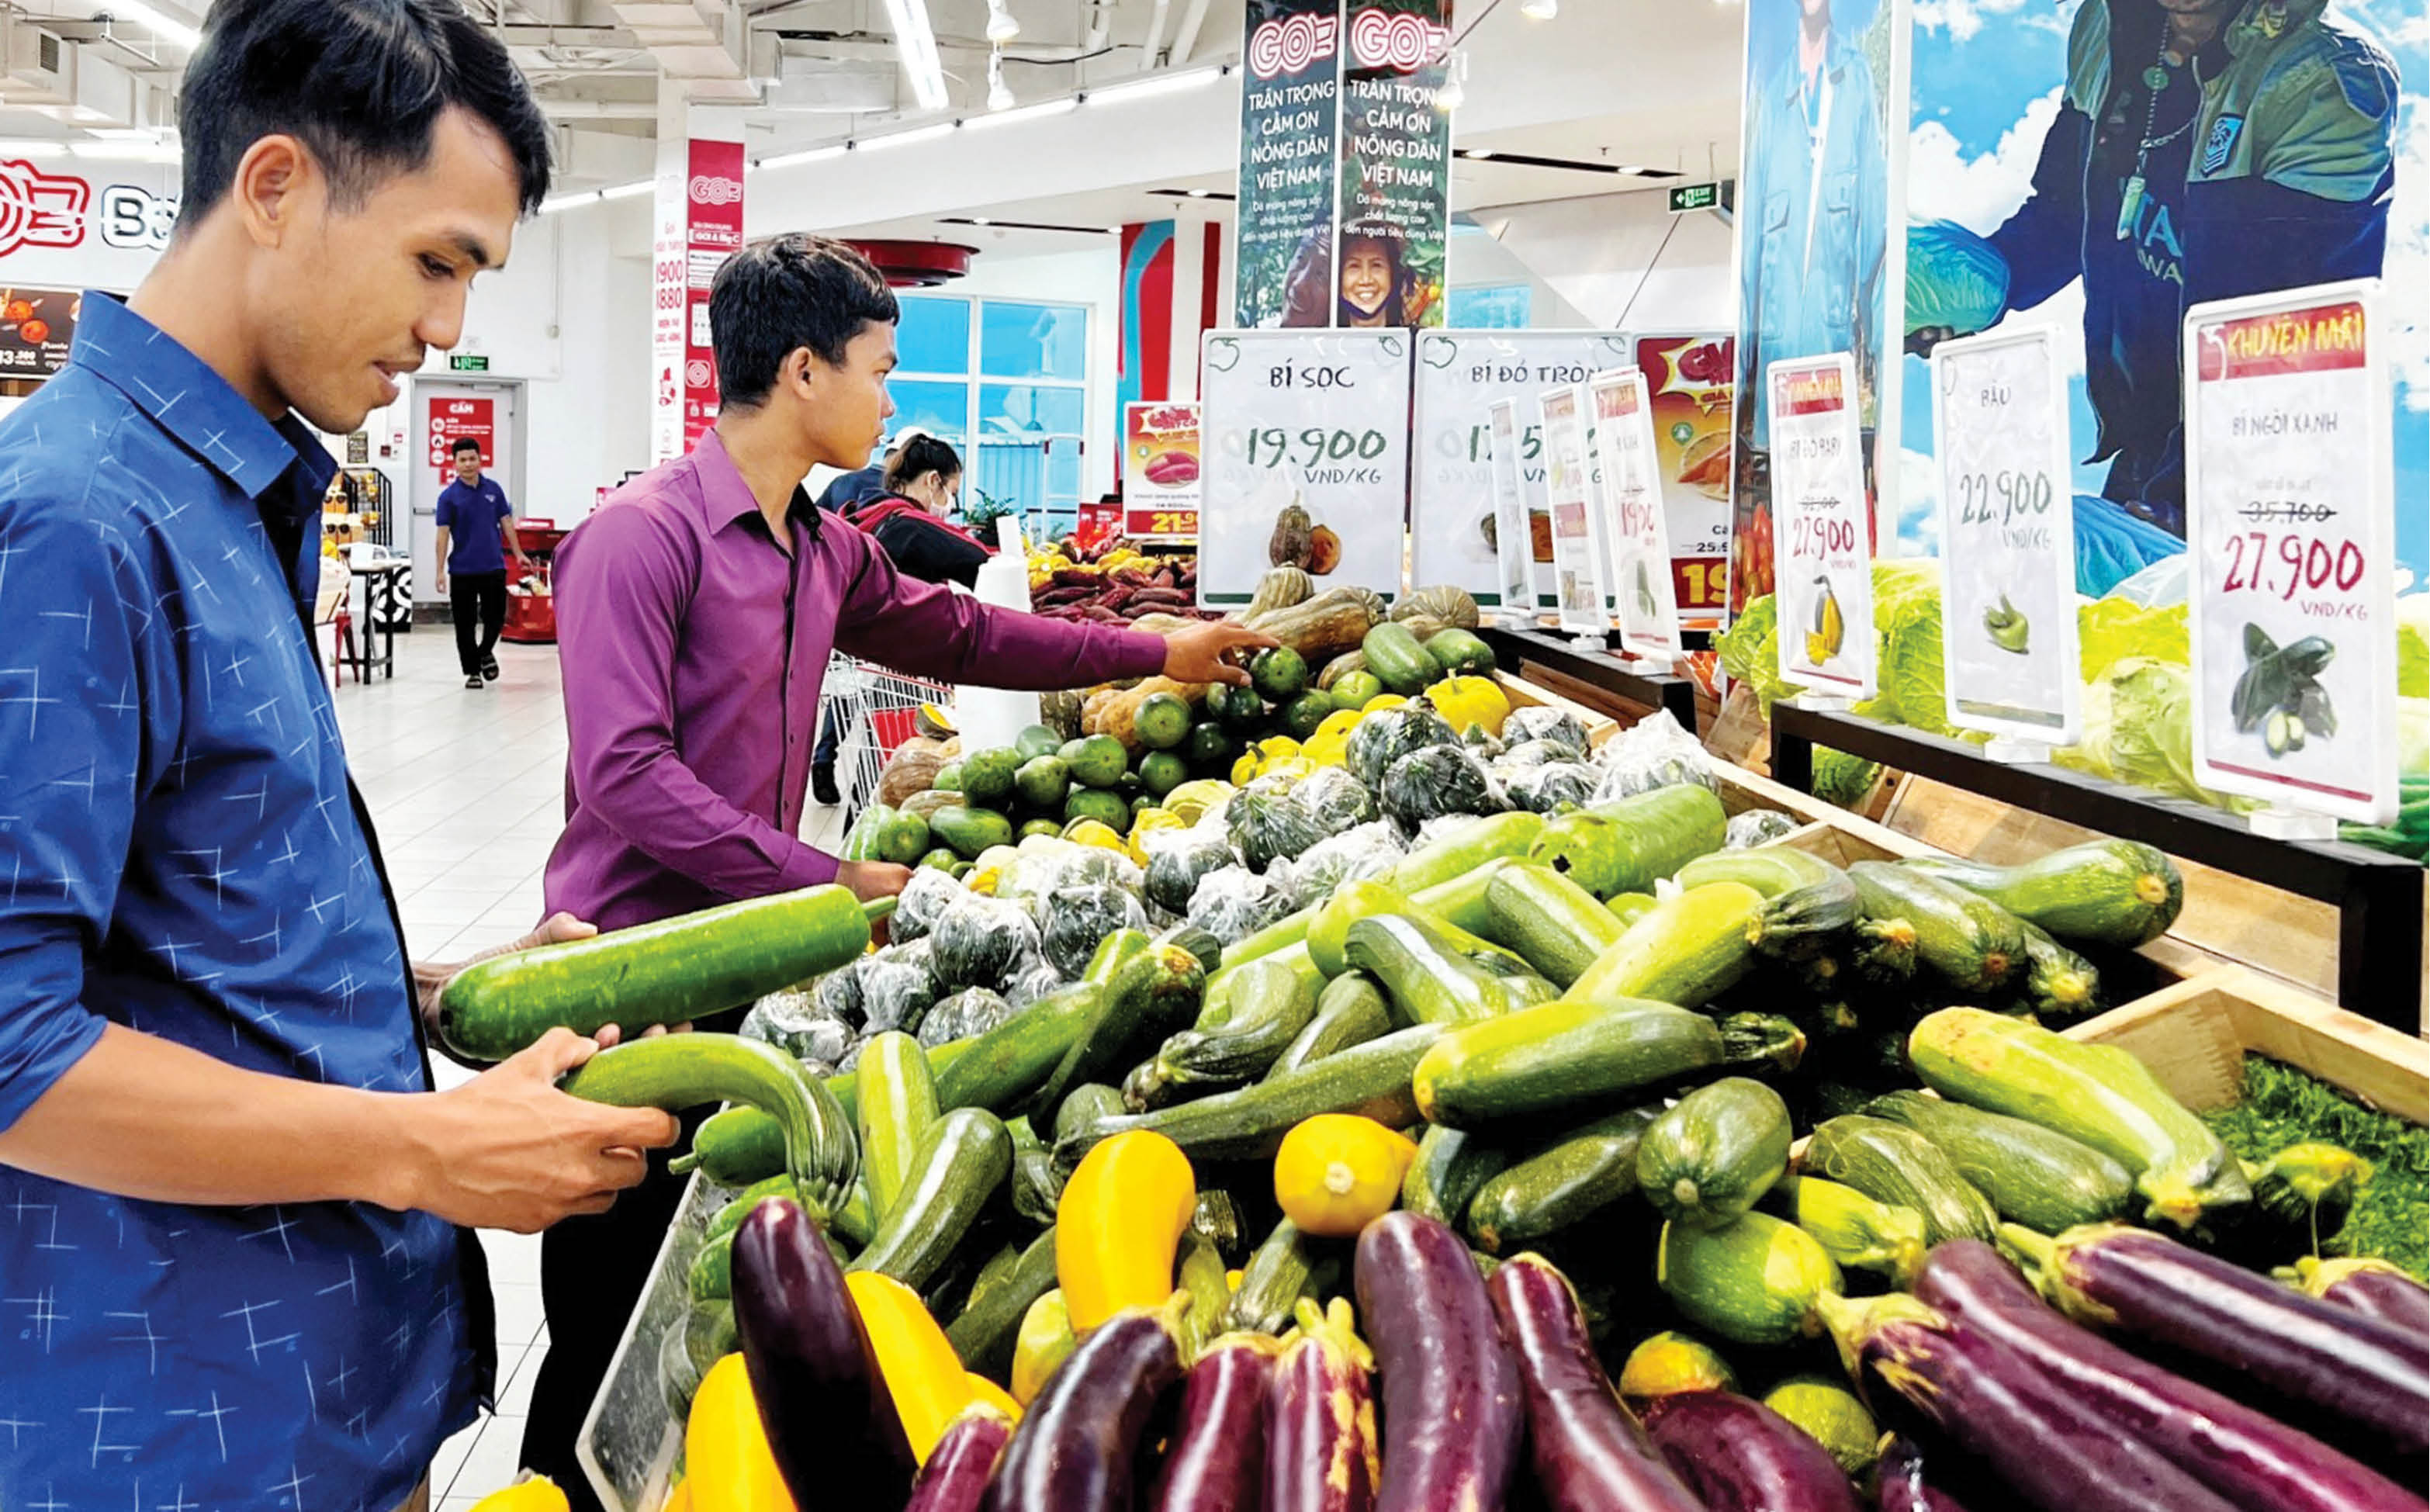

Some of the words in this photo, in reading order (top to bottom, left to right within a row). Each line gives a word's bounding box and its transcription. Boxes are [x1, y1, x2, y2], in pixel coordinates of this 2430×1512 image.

[1248, 88, 1284, 111] TRÂN
[1285, 80, 1335, 106] TRỌNG
[1350, 78, 1392, 102] TRÂN
[1394, 85, 1435, 109] TRỌN
[1366, 104, 1403, 130] CẢM
[1251, 140, 1294, 164] NÔNG
[1296, 133, 1328, 157] DÂN
[1354, 133, 1405, 157] NÔNG
[1257, 168, 1285, 192] VIỆT
[1287, 164, 1321, 185] NAM
[1361, 161, 1395, 189] VIỆT
[1396, 167, 1434, 189] NAM
[656, 260, 683, 284] 1900
[656, 286, 683, 310] 1880
[1270, 357, 1293, 389] BÍ
[1300, 366, 1355, 392] SỌC
[1472, 359, 1492, 383] BÍ
[1248, 427, 1387, 469] 19.900
[1304, 468, 1382, 484] VND/KG
[1960, 470, 2051, 526] 22.900
[1793, 516, 1855, 561] 27.900
[2223, 532, 2364, 600] 27.900
[2301, 600, 2369, 621] VND/KG
